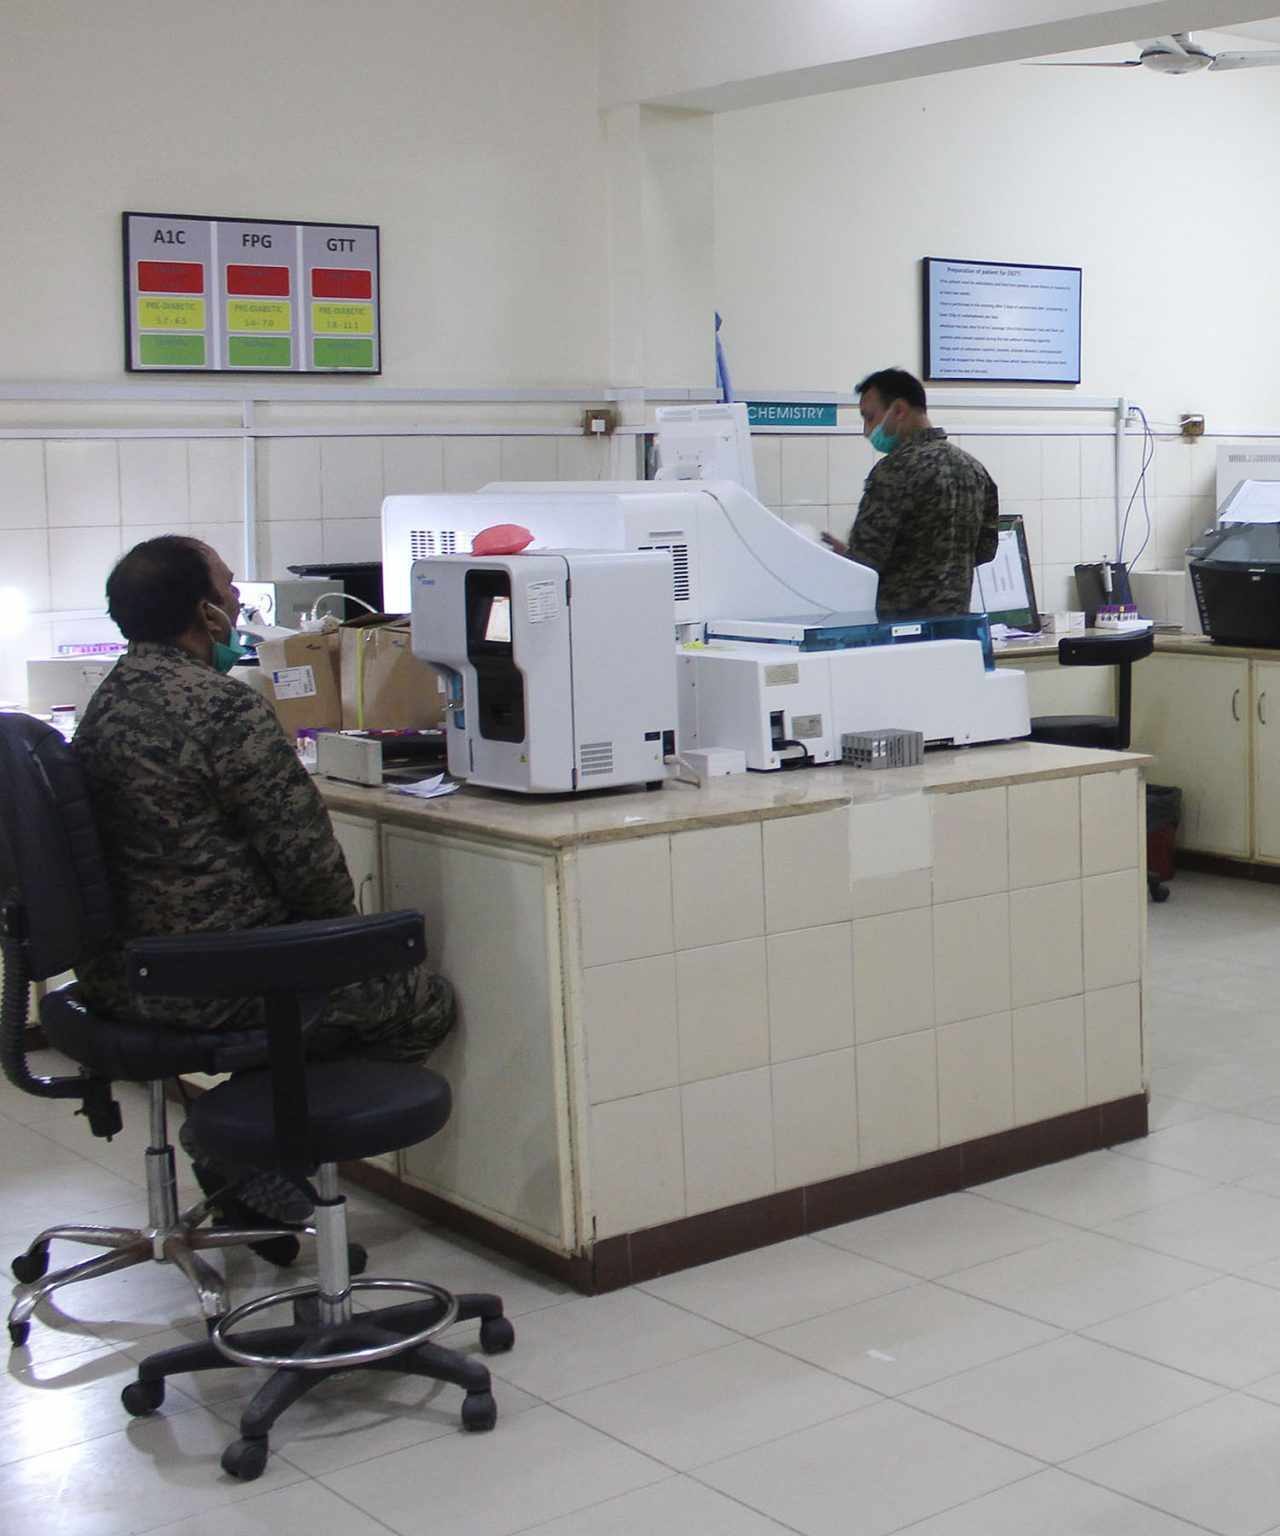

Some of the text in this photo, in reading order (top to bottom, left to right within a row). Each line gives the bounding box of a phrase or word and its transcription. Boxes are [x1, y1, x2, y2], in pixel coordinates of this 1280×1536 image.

[153, 230, 186, 245] A1C
[242, 234, 272, 249] FPG
[326, 238, 356, 253] GTT
[748, 406, 824, 420] CHEMISTRY
